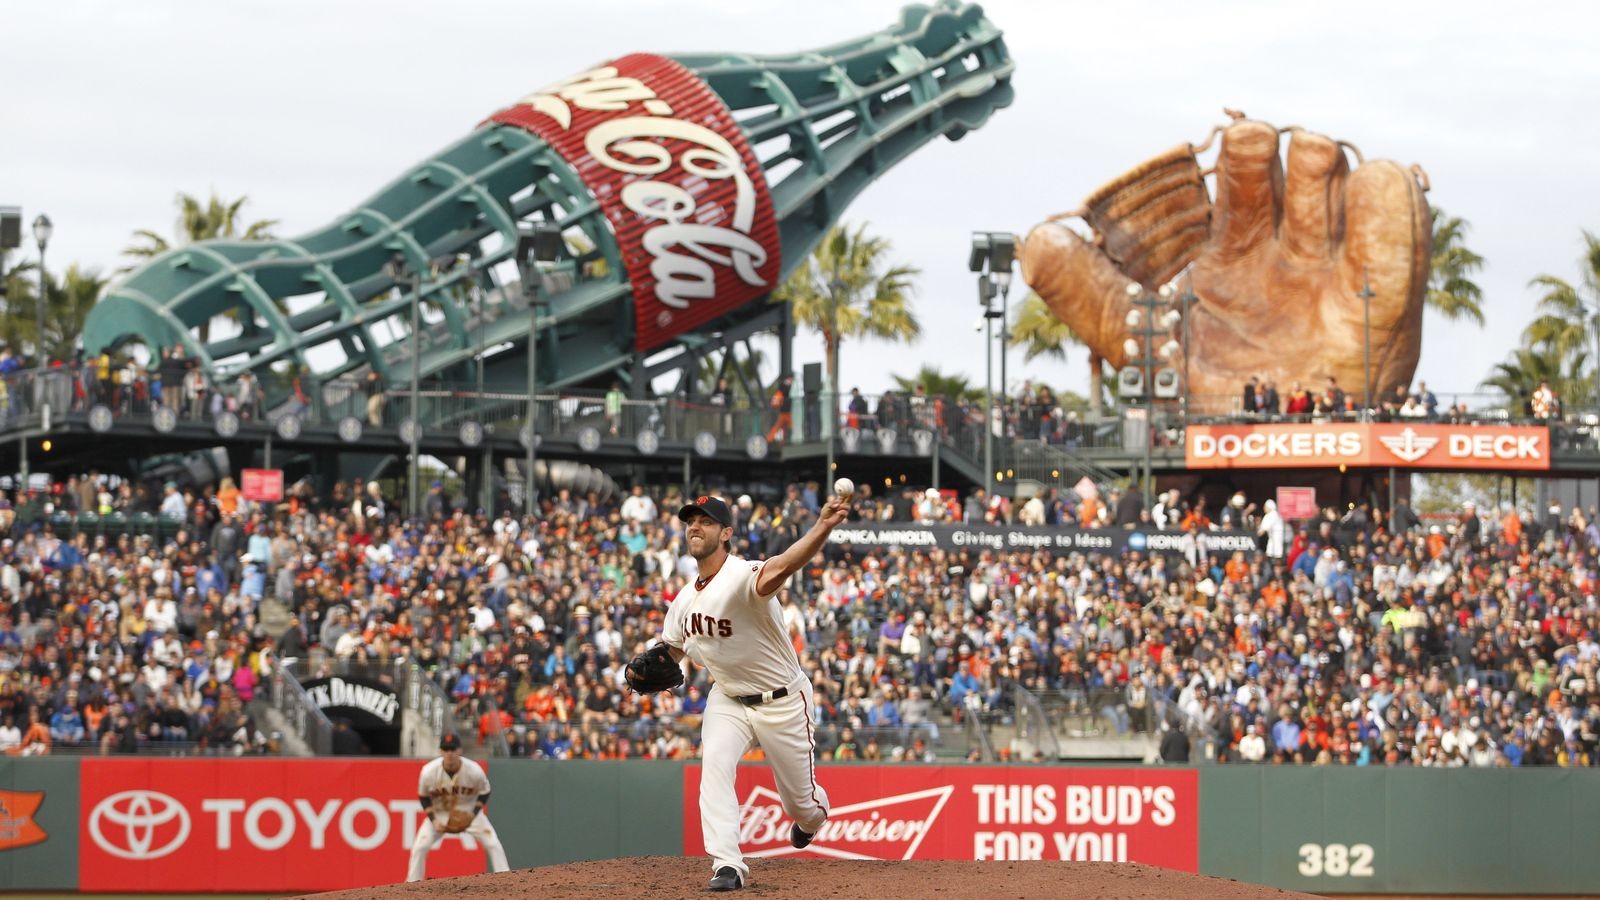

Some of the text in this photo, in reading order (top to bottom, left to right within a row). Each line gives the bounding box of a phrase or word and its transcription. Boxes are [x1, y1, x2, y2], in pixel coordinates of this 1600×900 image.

[1193, 431, 1542, 460] DOCKERS DECK
[878, 530, 938, 546] MINOLTA
[951, 530, 1113, 549] Giving Shape to Ideas
[972, 784, 1176, 826] THIS BUD'S
[738, 804, 928, 846] Buweiser
[974, 832, 1045, 861] FOR
[1298, 843, 1375, 877] 382
